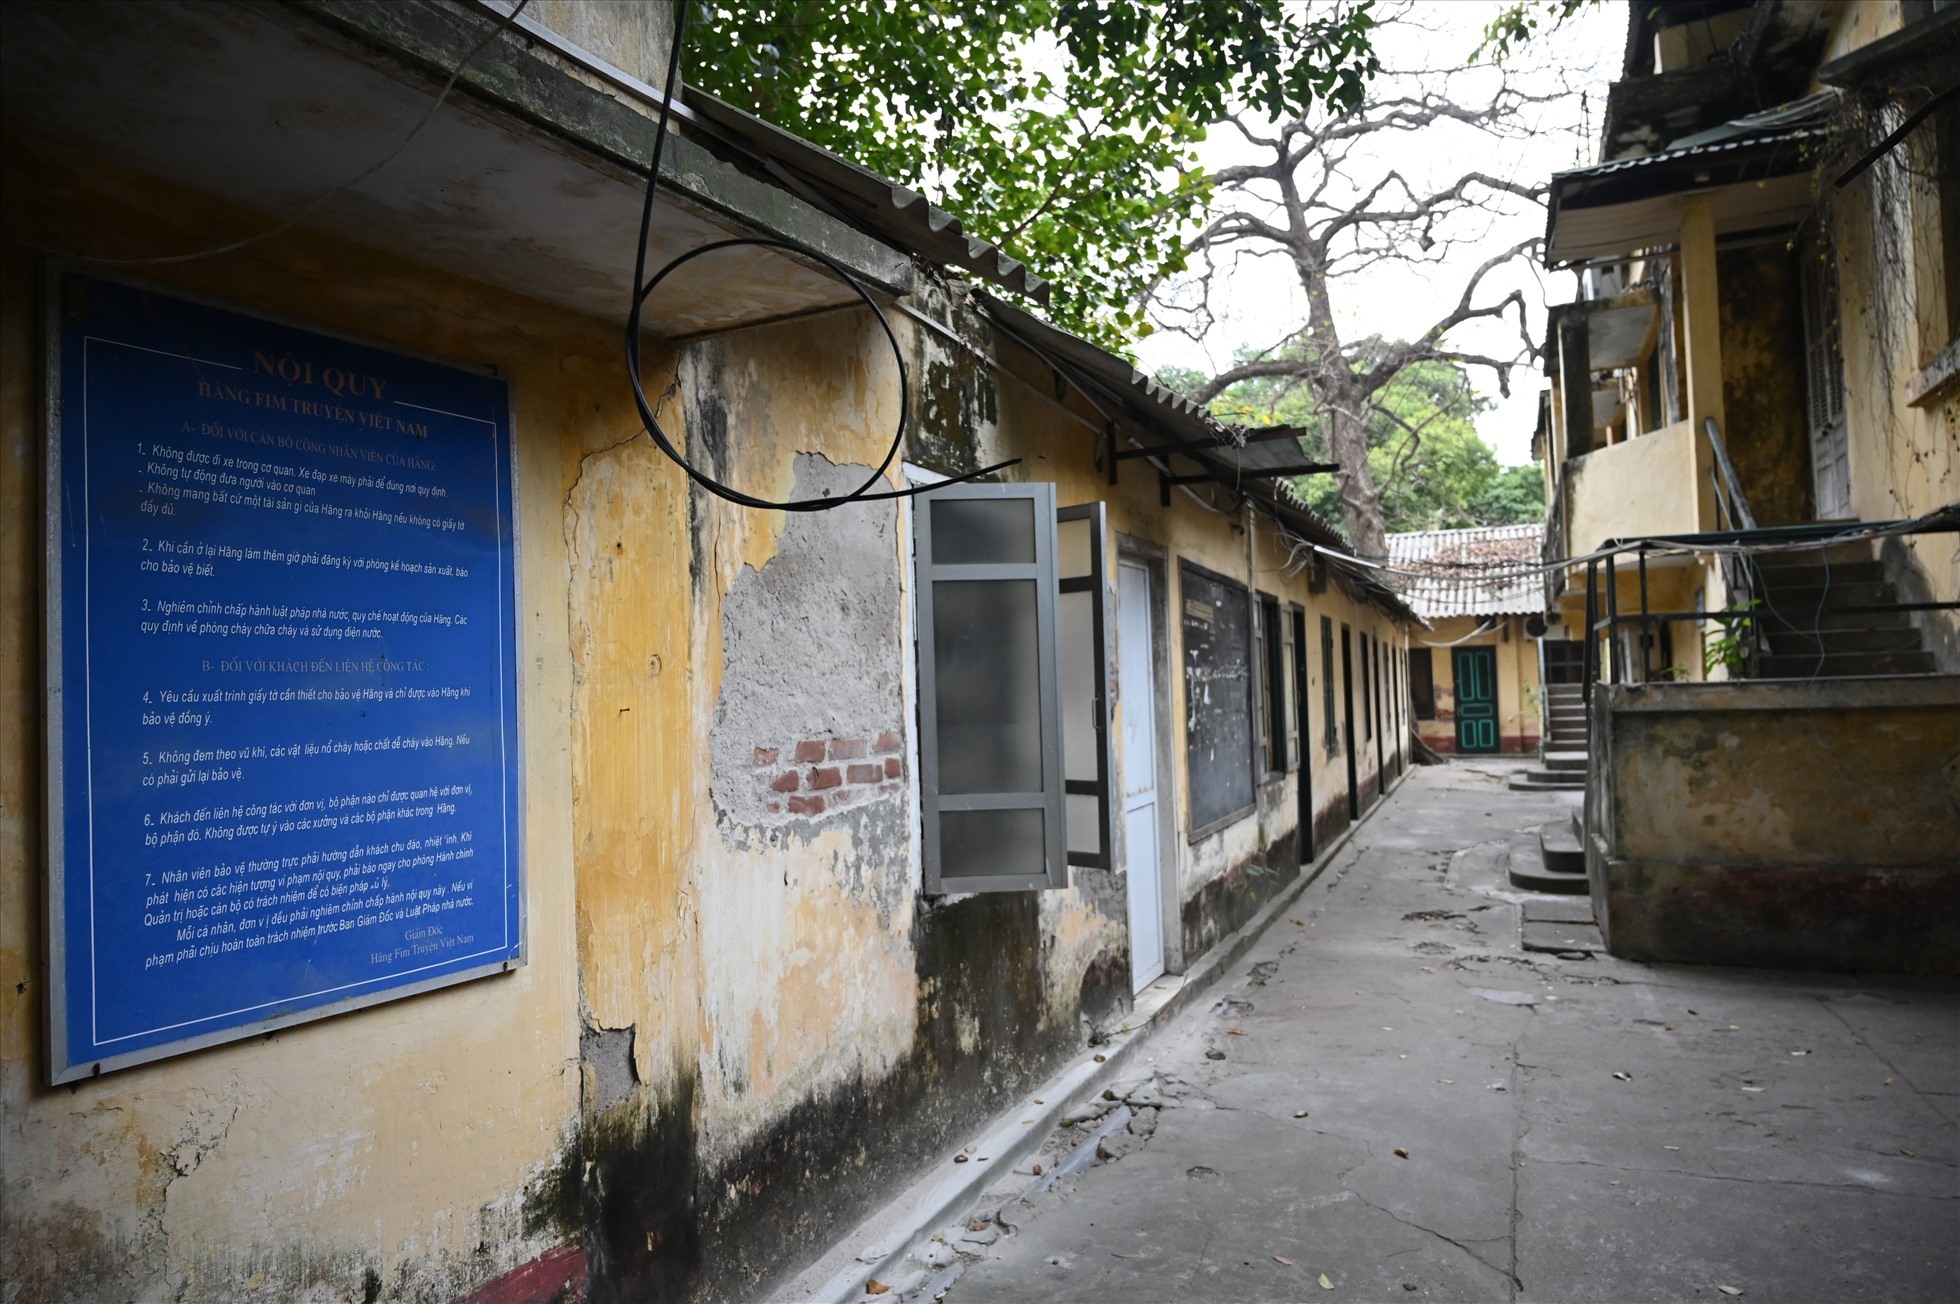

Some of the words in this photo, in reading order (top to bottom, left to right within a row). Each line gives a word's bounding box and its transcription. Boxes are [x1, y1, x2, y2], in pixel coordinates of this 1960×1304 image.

[322, 367, 389, 400] QUY
[255, 391, 286, 411] FIM
[396, 418, 428, 438] NAM
[295, 437, 326, 455] CÔNG
[328, 443, 358, 459] NHÂN
[359, 448, 384, 463] VIÊN
[146, 461, 179, 481] Không
[219, 472, 237, 486] đưa
[283, 483, 295, 493] cơ
[295, 485, 316, 497] quan
[152, 444, 184, 464] Không
[212, 453, 222, 466] đi
[222, 457, 235, 468] xe
[236, 457, 259, 474] trong
[260, 463, 272, 473] cơ
[273, 465, 296, 477] quan.
[298, 466, 310, 479] Xe
[311, 468, 328, 484] đạp
[328, 473, 339, 483] xe
[339, 473, 357, 488] máy
[357, 475, 375, 489] phải
[385, 479, 405, 495] đúng
[405, 483, 417, 494] nơi
[417, 486, 431, 498] quy
[147, 481, 181, 500] Không
[182, 488, 211, 504] mang
[275, 496, 292, 511] sản
[303, 500, 320, 514] của
[321, 503, 343, 519] Hãng
[344, 508, 353, 518] ra
[354, 507, 371, 520] khỏi
[371, 509, 393, 525] Hãng
[408, 514, 432, 530] không
[432, 517, 442, 528] có
[140, 558, 159, 572] cho
[161, 559, 180, 574] bảo
[157, 539, 175, 553] Khi
[204, 543, 217, 559] lại
[218, 545, 243, 562] Hãng
[262, 549, 285, 562] thêm
[300, 551, 320, 566] phải
[320, 554, 341, 569] đăng
[342, 555, 352, 570] ký
[400, 561, 423, 575] hoạch
[423, 562, 437, 575] sản
[455, 566, 469, 578] báo
[156, 600, 195, 616] Nghiêm
[196, 599, 223, 614] chỉnh
[289, 606, 311, 621] pháp
[351, 611, 367, 624] quy
[382, 610, 400, 624] hoạt
[418, 611, 433, 623] của
[454, 613, 468, 625] Các
[140, 621, 160, 635] quy
[161, 619, 184, 635] định
[230, 622, 253, 638] cháy
[277, 624, 298, 639] cháy
[322, 625, 343, 640] dụng
[268, 658, 308, 673] KHÁCH
[335, 658, 359, 673] LIÊN
[376, 659, 404, 672] CÔNG
[405, 658, 425, 672] TÁC
[159, 689, 180, 703] Yêu
[317, 688, 333, 701] cho
[334, 687, 350, 701] bảo
[362, 688, 384, 702] Hãng
[394, 686, 408, 699] chỉ
[440, 687, 460, 700] Hãng
[460, 686, 471, 697] khi
[142, 710, 162, 726] bảo
[158, 750, 191, 765] Không
[192, 749, 214, 762] đem
[216, 748, 237, 760] theo
[269, 744, 286, 758] các
[333, 741, 353, 755] cháy
[402, 737, 420, 751] cháy
[142, 773, 155, 787] có
[156, 769, 179, 789] phải
[198, 769, 210, 785] lại
[211, 766, 229, 781] bảo
[159, 810, 191, 825] Khách
[213, 806, 230, 820] liên
[245, 803, 268, 819] công
[269, 801, 283, 814] tác
[298, 799, 315, 812] đơn
[377, 789, 390, 803] chỉ
[409, 789, 428, 802] quan
[450, 784, 464, 796] đơn
[204, 825, 235, 841] Không
[271, 820, 278, 836] ý
[296, 817, 312, 831] các
[350, 812, 365, 825] các
[396, 806, 415, 819] khác
[415, 806, 434, 818] trong
[161, 869, 188, 884] Nhân
[191, 866, 211, 881] viên
[213, 862, 232, 878] bảo
[300, 850, 320, 868] phải
[365, 842, 389, 856] khách
[390, 841, 405, 853] chu
[460, 830, 473, 843] Khi
[196, 885, 209, 900] có
[210, 883, 228, 897] các
[277, 874, 286, 887] vi
[286, 873, 311, 889] phạm
[325, 869, 342, 882] quy,
[343, 862, 361, 880] phải
[361, 862, 377, 874] báo
[377, 861, 397, 874] ngay
[397, 857, 412, 869] cho
[455, 847, 474, 860] chính
[143, 909, 171, 927] Quản
[173, 908, 184, 922] trị
[210, 902, 228, 916] cán
[243, 896, 255, 911] có
[256, 893, 279, 909] trách
[319, 885, 330, 898] có
[348, 879, 369, 896] pháp
[196, 924, 209, 939] cá
[239, 918, 257, 931] đơn
[289, 906, 309, 925] phải
[309, 903, 340, 921] nghiêm
[341, 898, 364, 913] chỉnh
[418, 888, 432, 901] quy
[466, 878, 474, 891] vi
[144, 953, 174, 969] phạm
[175, 944, 197, 964] phải
[199, 942, 220, 957] chịu
[267, 929, 289, 945] trách
[339, 919, 355, 931] Ban
[356, 913, 378, 927] Giám
[421, 901, 441, 915] Pháp
[370, 952, 393, 965] Hãng
[394, 947, 411, 959] Fim
[456, 934, 474, 945] Nam
[404, 927, 426, 941] Giám
